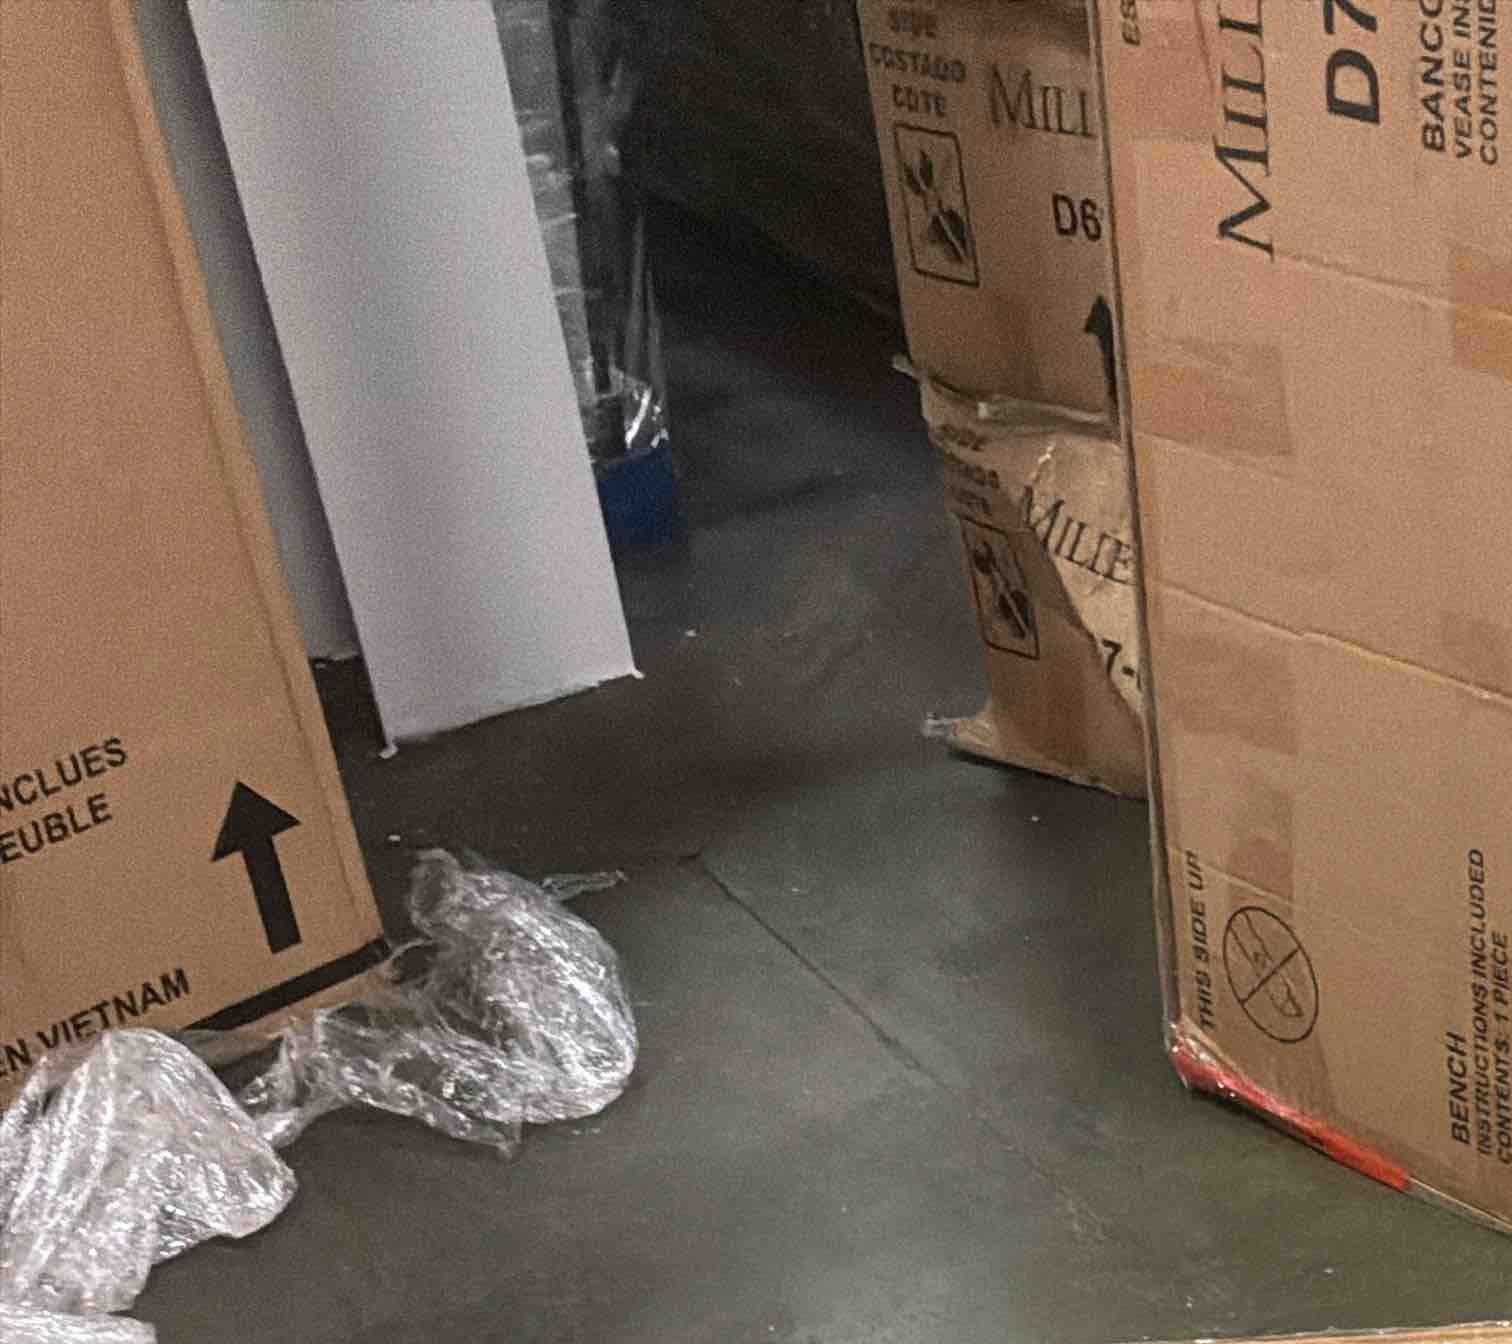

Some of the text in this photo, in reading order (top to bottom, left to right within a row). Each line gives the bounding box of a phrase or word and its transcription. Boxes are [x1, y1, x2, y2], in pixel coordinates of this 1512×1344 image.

[1452, 0, 1473, 159] VEASE IN
[1184, 849, 1204, 891] UP
[36, 966, 191, 1050] VIETNAM
[1467, 848, 1492, 1157] INSTRUCTIONS INCLUDED
[1492, 931, 1510, 1009] PIECE
[1447, 1031, 1470, 1146] BENCH
